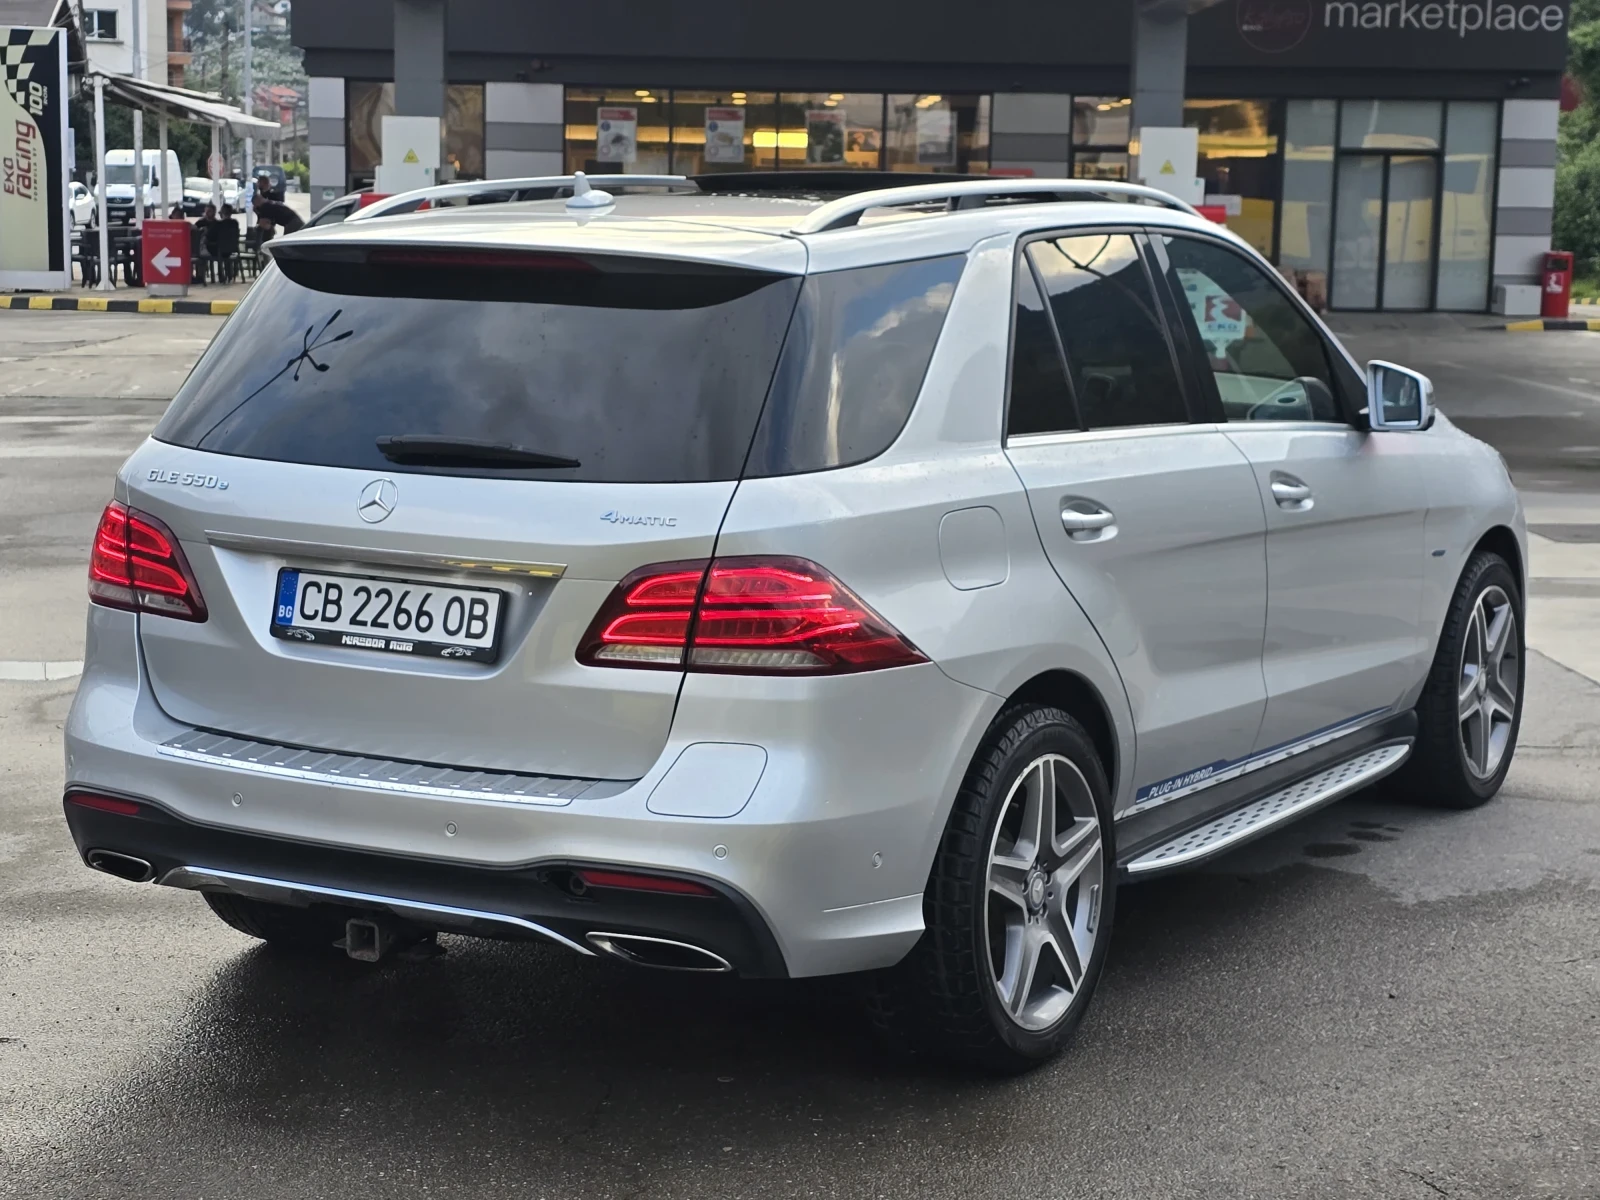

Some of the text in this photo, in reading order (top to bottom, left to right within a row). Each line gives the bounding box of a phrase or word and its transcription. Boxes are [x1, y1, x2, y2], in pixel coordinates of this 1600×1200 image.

[1324, 0, 1563, 38] marketplace
[29, 81, 43, 116] 100
[3, 157, 14, 195] EKO
[16, 119, 36, 200] racing
[147, 468, 229, 490] GLE 550e
[600, 510, 678, 527] 4MATIC
[278, 604, 293, 618] BG
[299, 581, 344, 622] CB
[349, 586, 434, 633] 2266
[1149, 766, 1213, 798] PLUG-IN HYBRID
